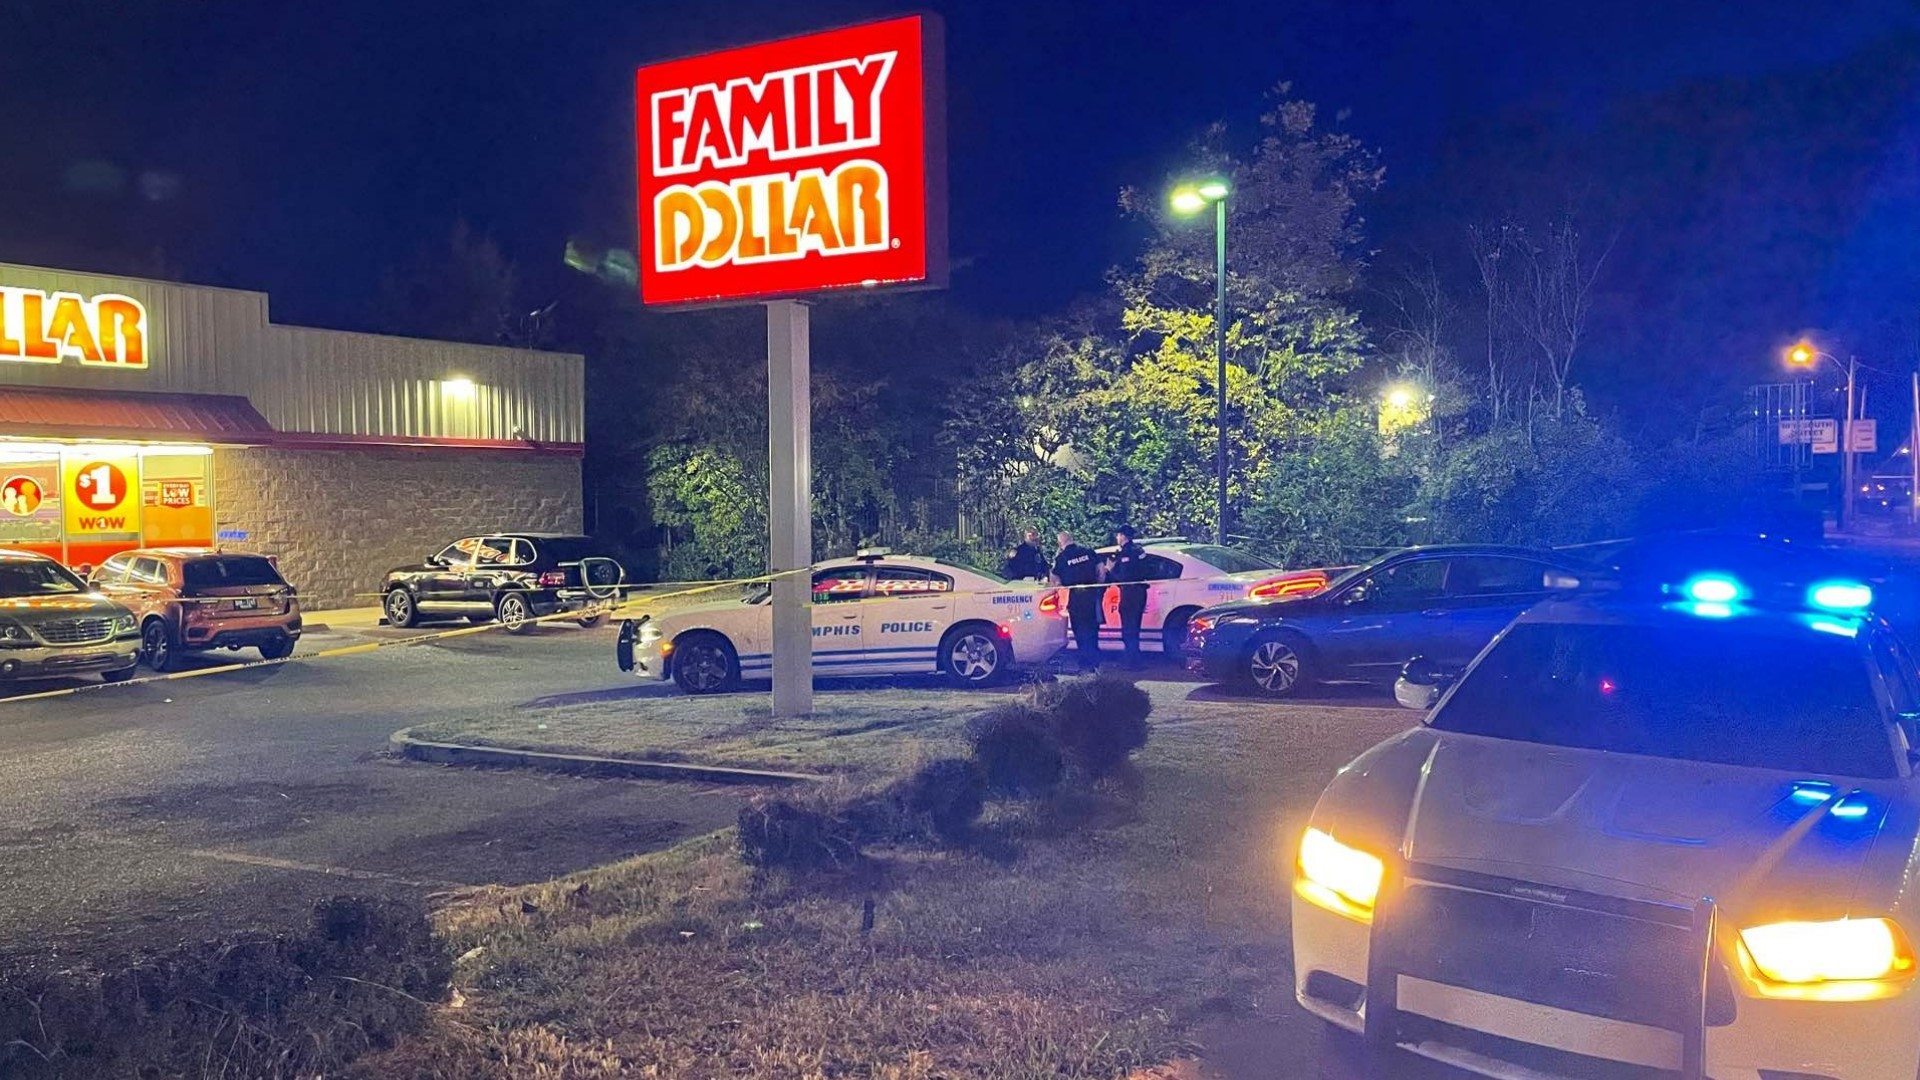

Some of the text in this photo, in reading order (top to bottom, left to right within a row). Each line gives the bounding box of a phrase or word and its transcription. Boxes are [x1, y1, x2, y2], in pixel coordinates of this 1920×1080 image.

[651, 50, 898, 177] FAMILY
[654, 159, 890, 272] DOLLAR
[79, 464, 116, 504] $1
[162, 487, 190, 497] LOW
[163, 497, 190, 505] PRICES
[1067, 555, 1090, 566] POLICE
[992, 595, 1033, 604] EMERGENCY
[881, 621, 933, 633] POLICE
